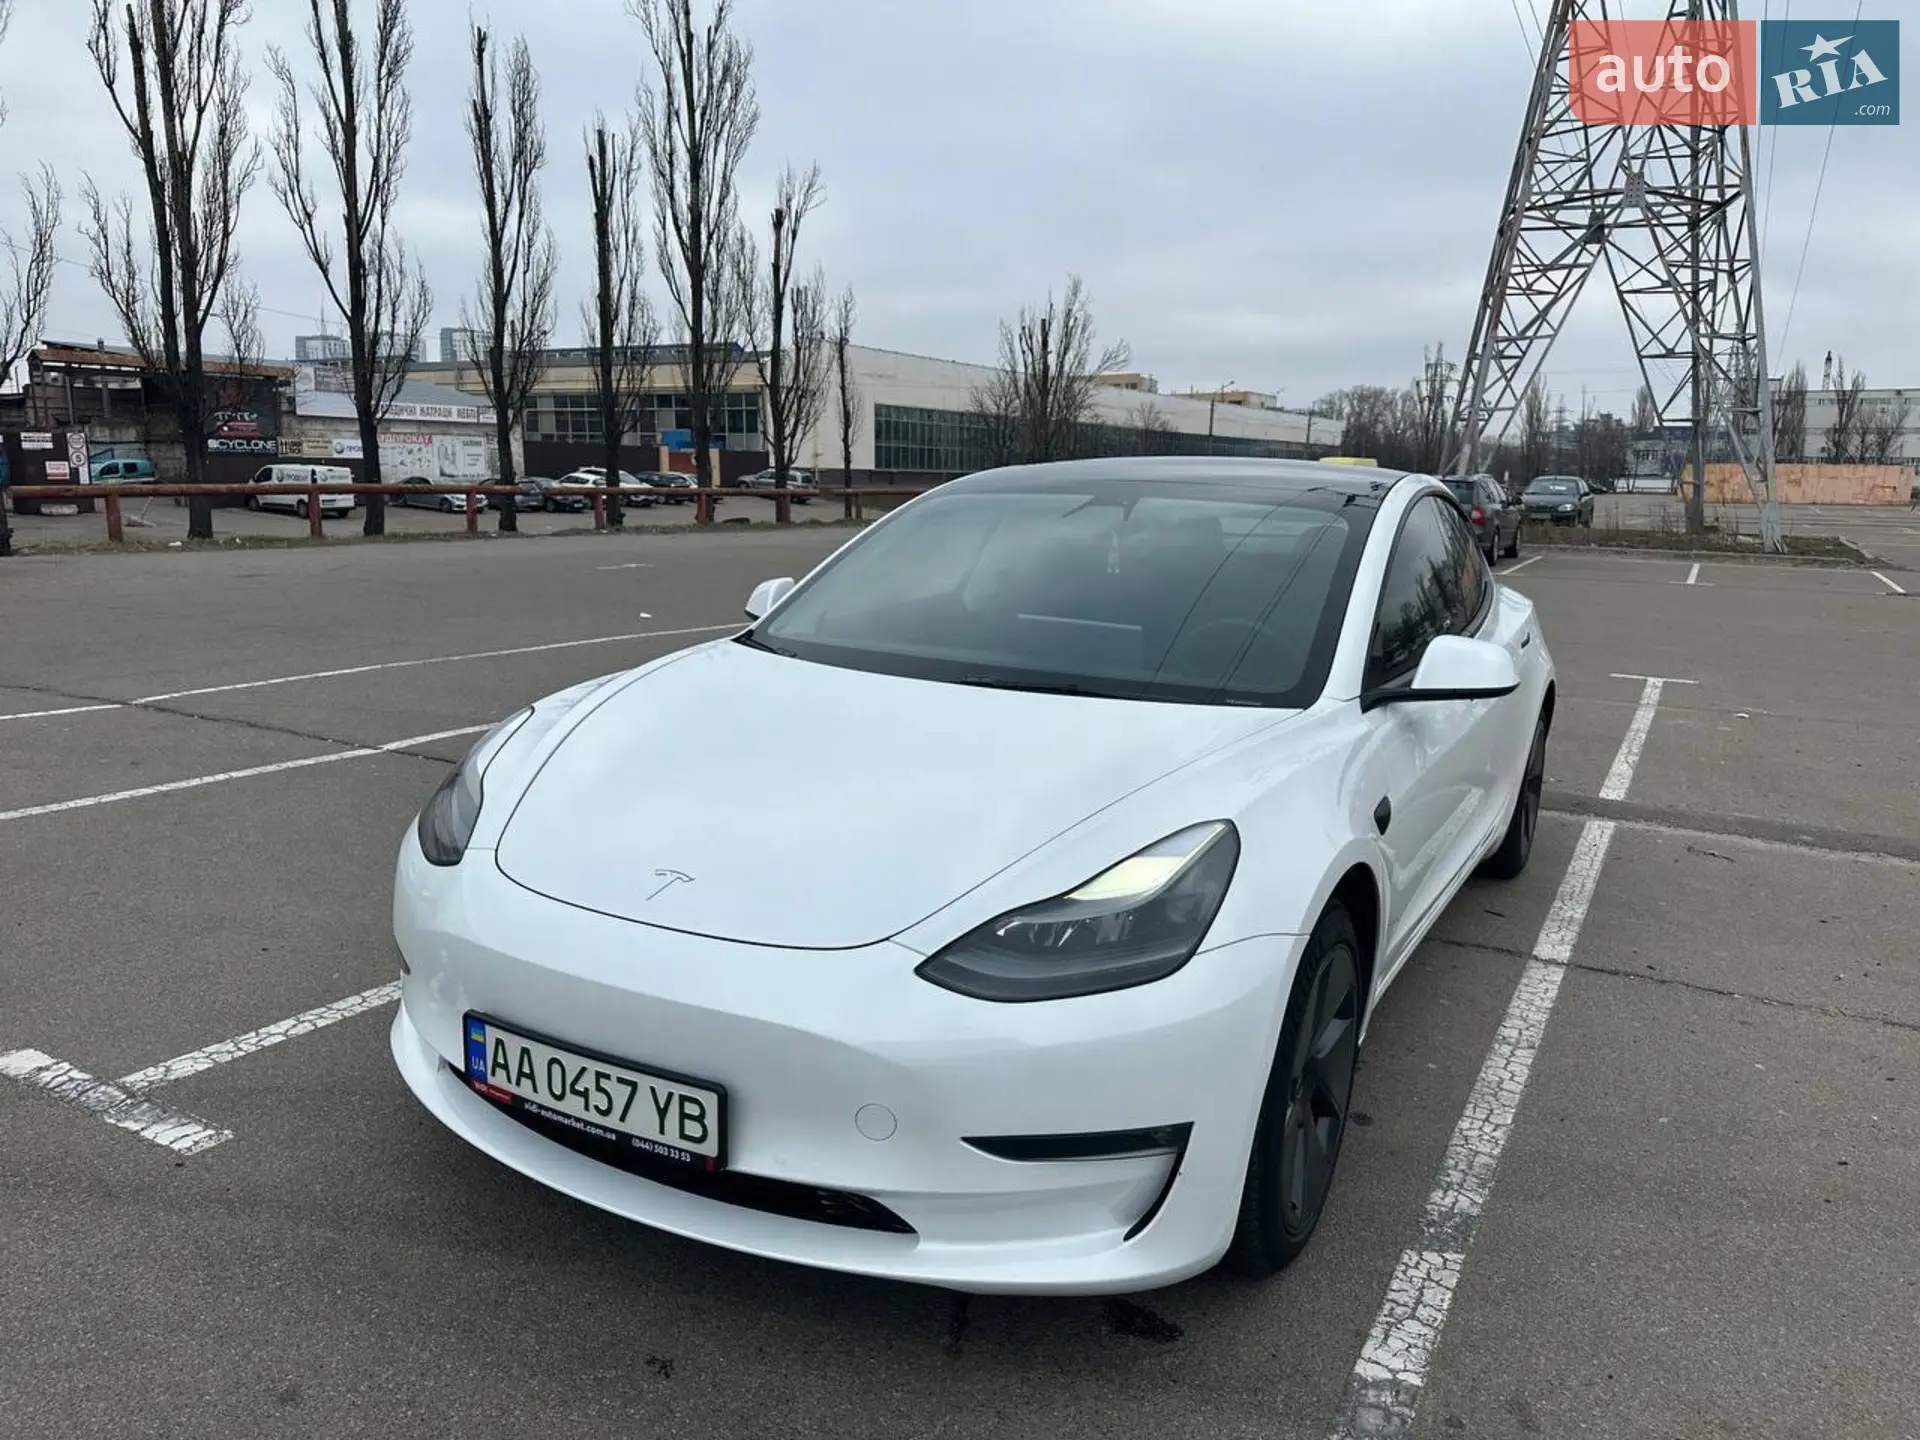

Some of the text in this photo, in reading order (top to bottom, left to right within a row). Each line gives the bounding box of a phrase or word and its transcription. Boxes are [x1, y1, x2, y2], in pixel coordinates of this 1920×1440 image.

[471, 1056, 486, 1072] UA
[491, 1037, 539, 1095] AA
[547, 1057, 639, 1123] 0457
[649, 1085, 708, 1144] YB
